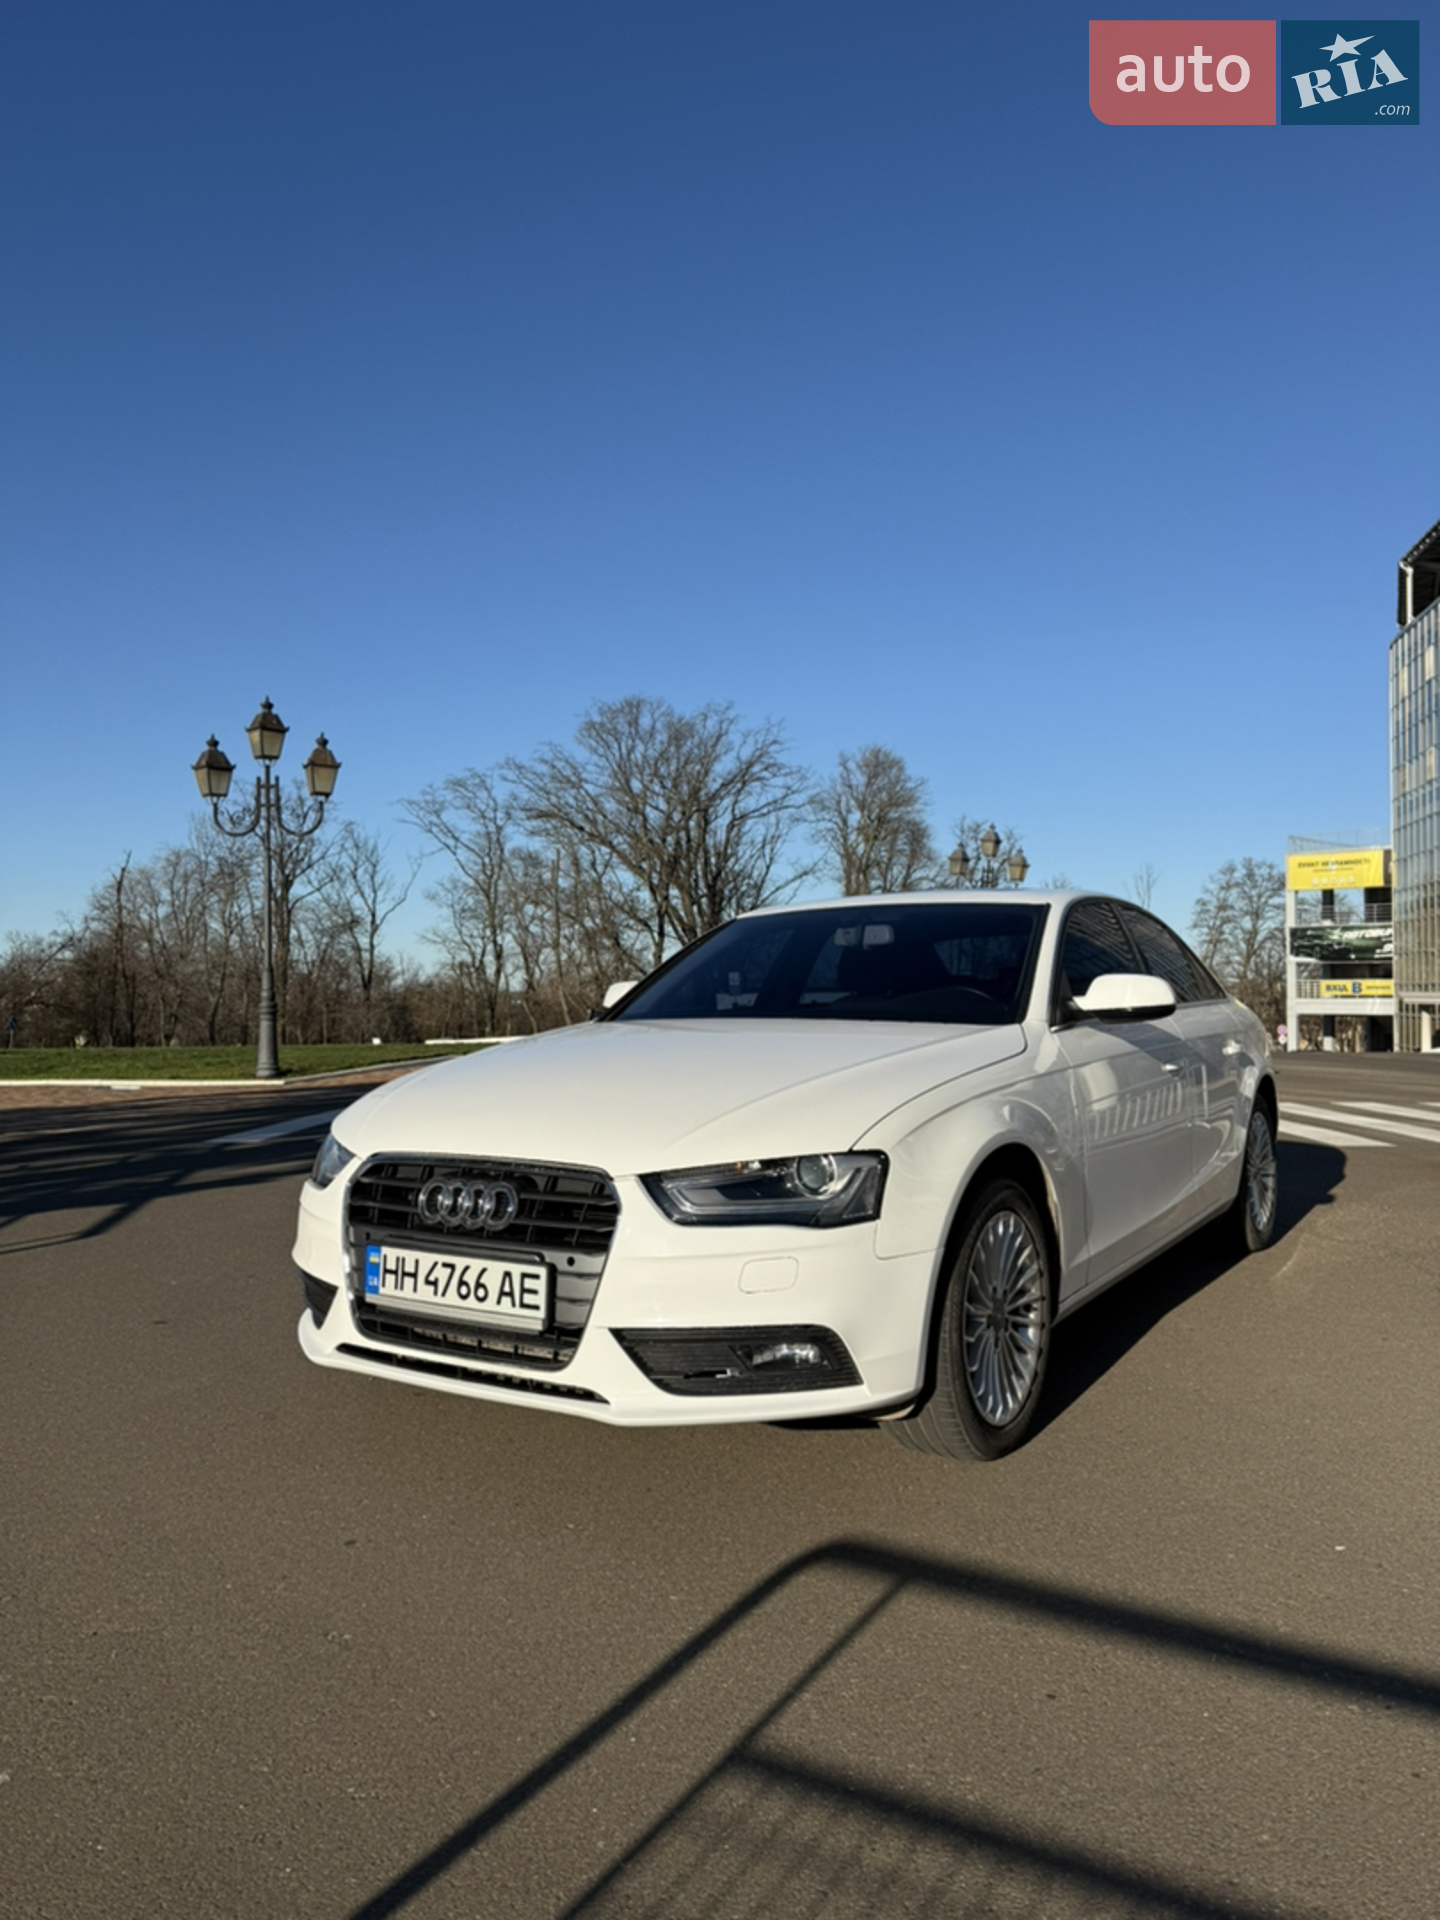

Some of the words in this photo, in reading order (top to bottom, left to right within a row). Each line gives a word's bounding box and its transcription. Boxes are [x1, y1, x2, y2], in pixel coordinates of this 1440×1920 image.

[381, 1253, 419, 1293] HH
[423, 1260, 489, 1303] 4766
[496, 1270, 541, 1311] AE
